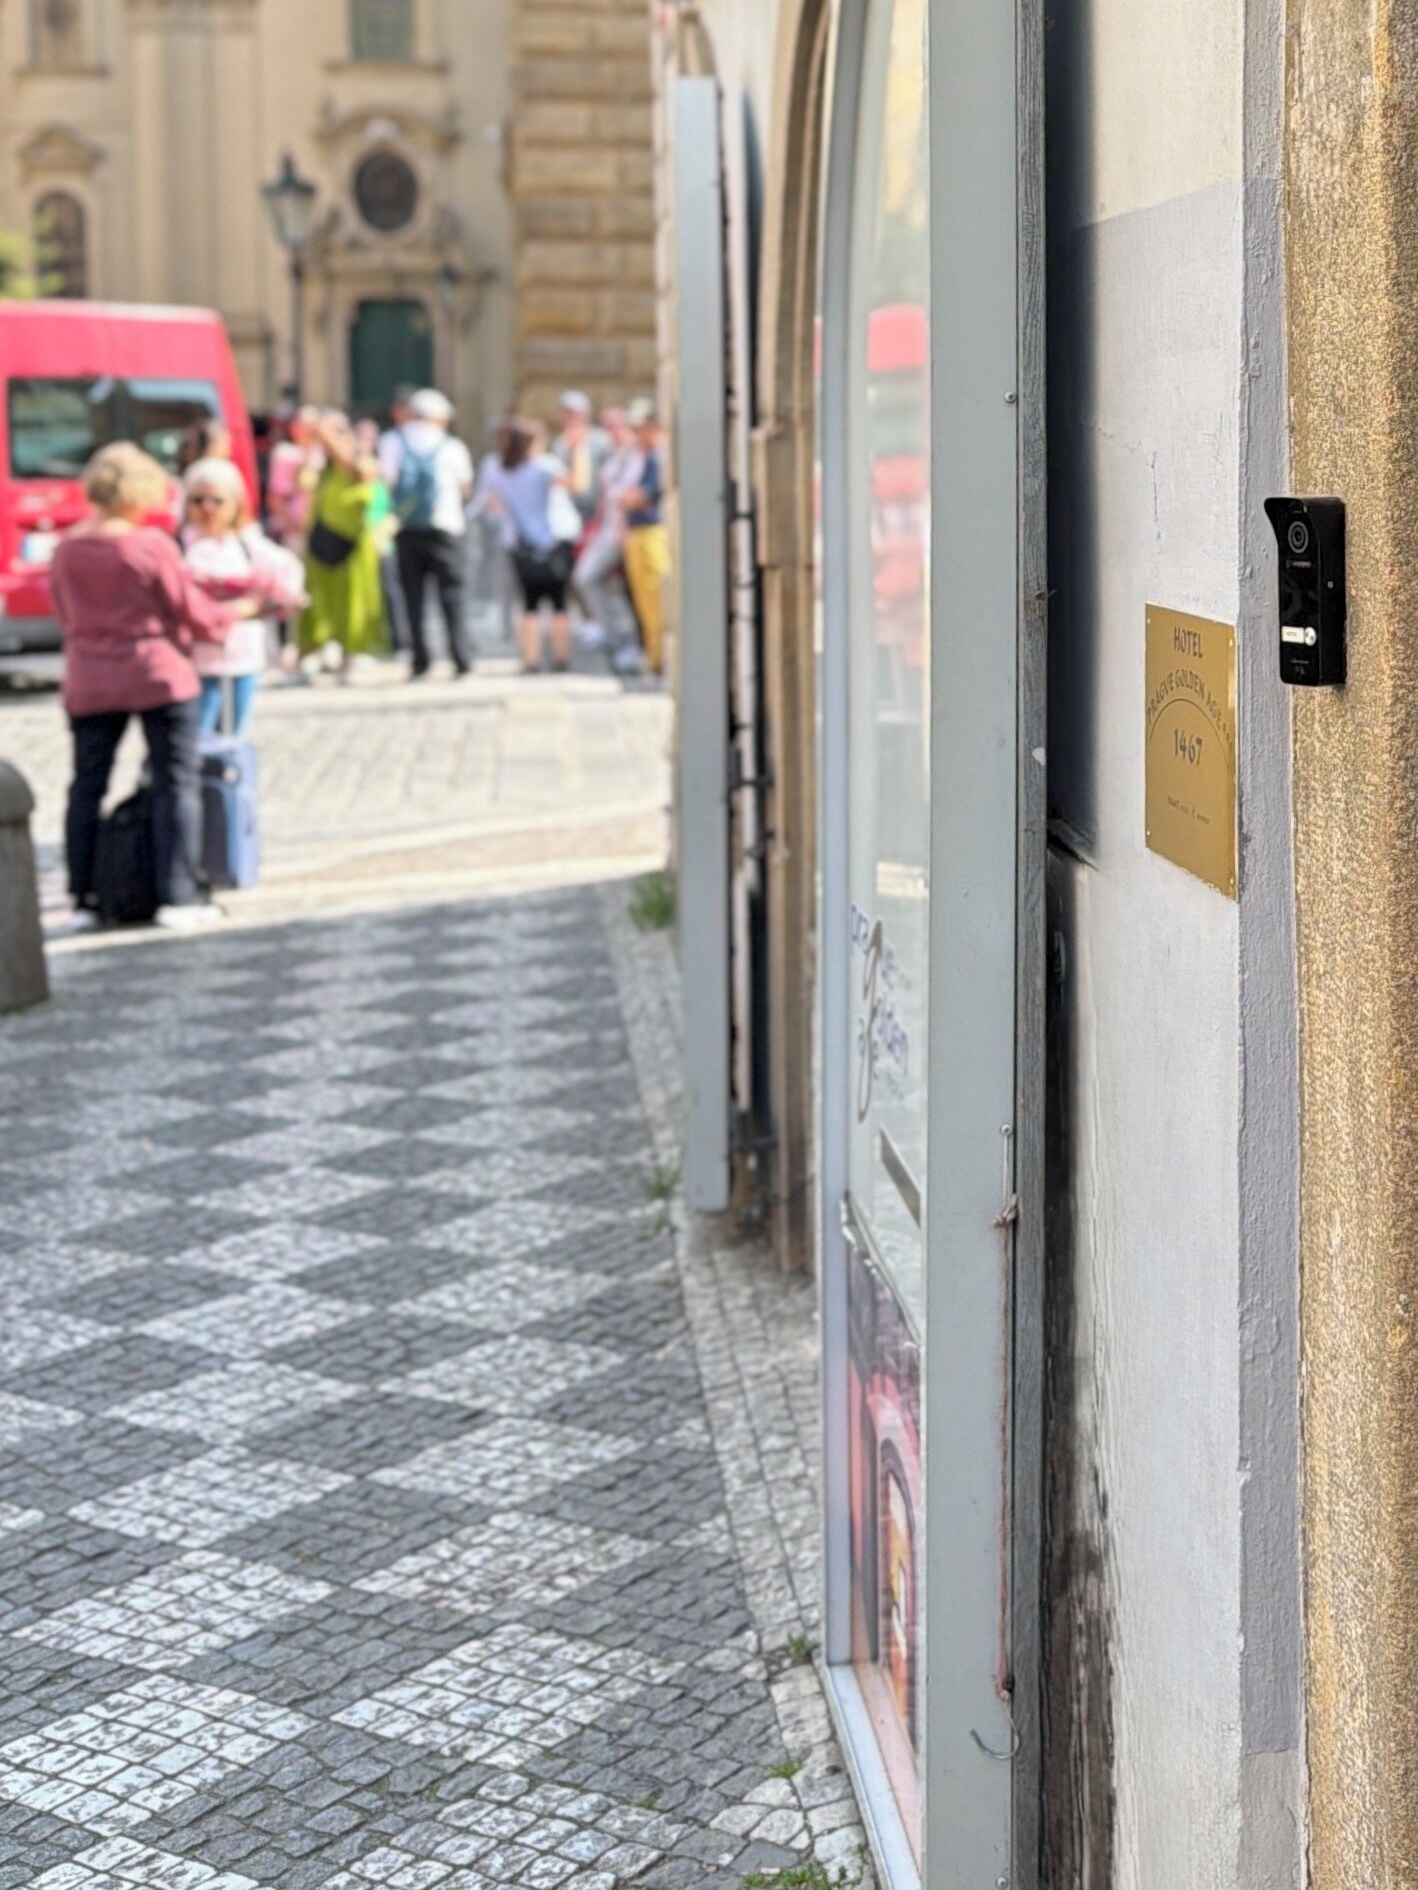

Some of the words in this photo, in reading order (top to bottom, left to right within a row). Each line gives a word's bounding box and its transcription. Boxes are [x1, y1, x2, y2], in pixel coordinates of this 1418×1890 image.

[1173, 625, 1203, 659] HOTEL
[1175, 668, 1205, 701] GOLDEN
[1206, 690, 1222, 730] AGE
[1173, 727, 1203, 767] 1467
